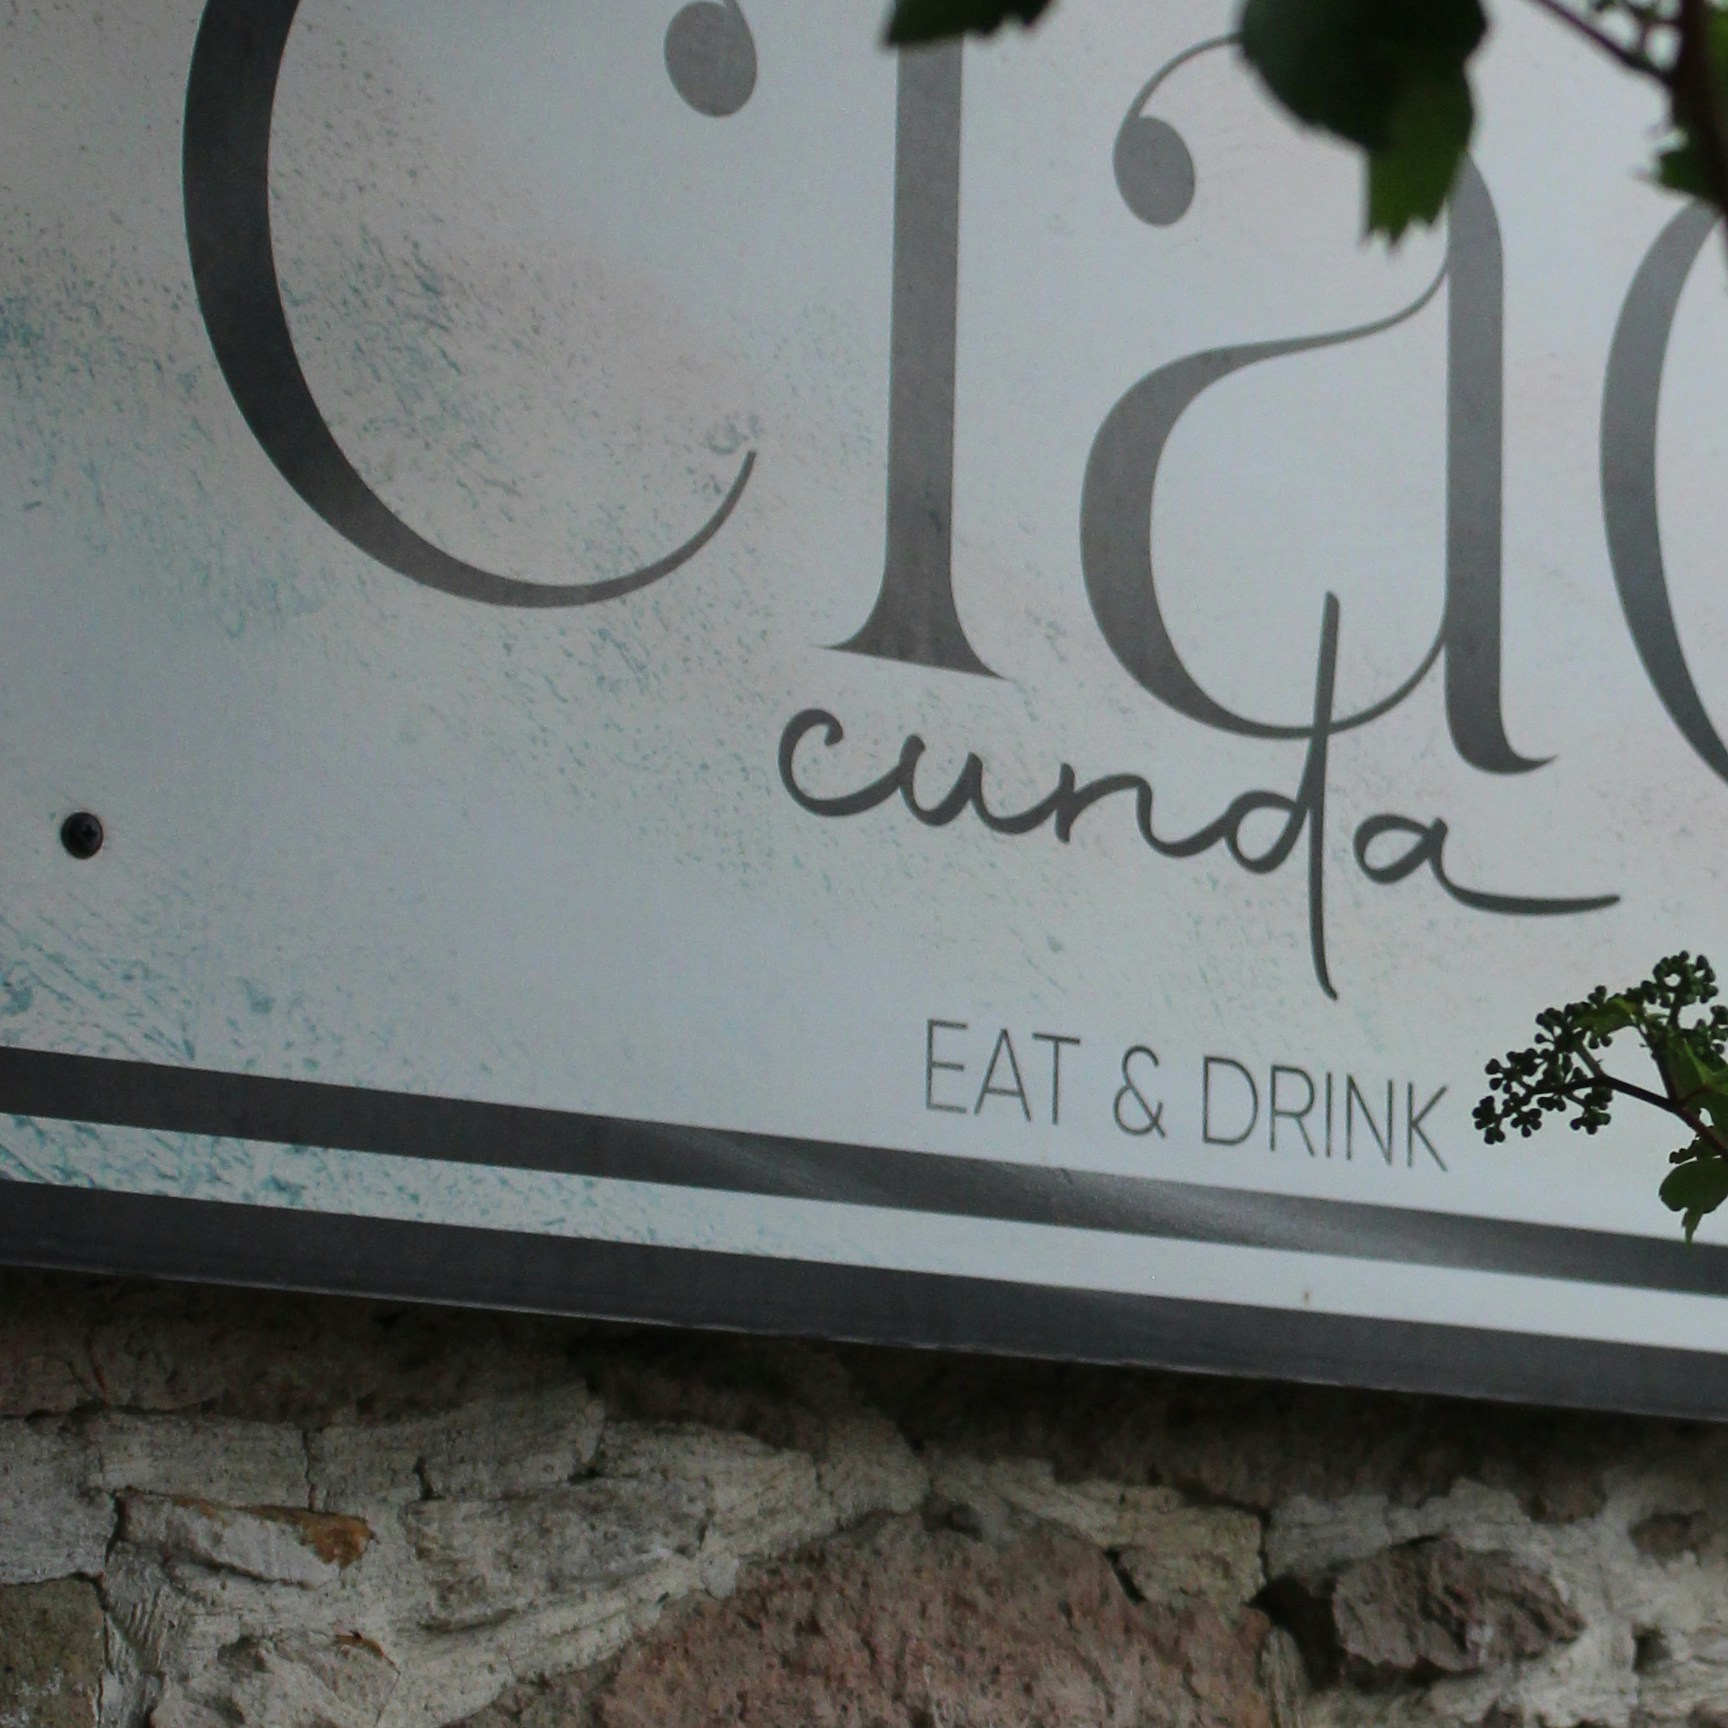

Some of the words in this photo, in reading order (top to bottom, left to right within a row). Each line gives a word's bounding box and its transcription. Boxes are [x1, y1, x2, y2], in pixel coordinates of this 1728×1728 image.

[778, 591, 1622, 1000] cunda
[924, 1017, 1082, 1125] EAT
[1112, 1044, 1167, 1139] &
[1201, 1055, 1450, 1172] DRINK
